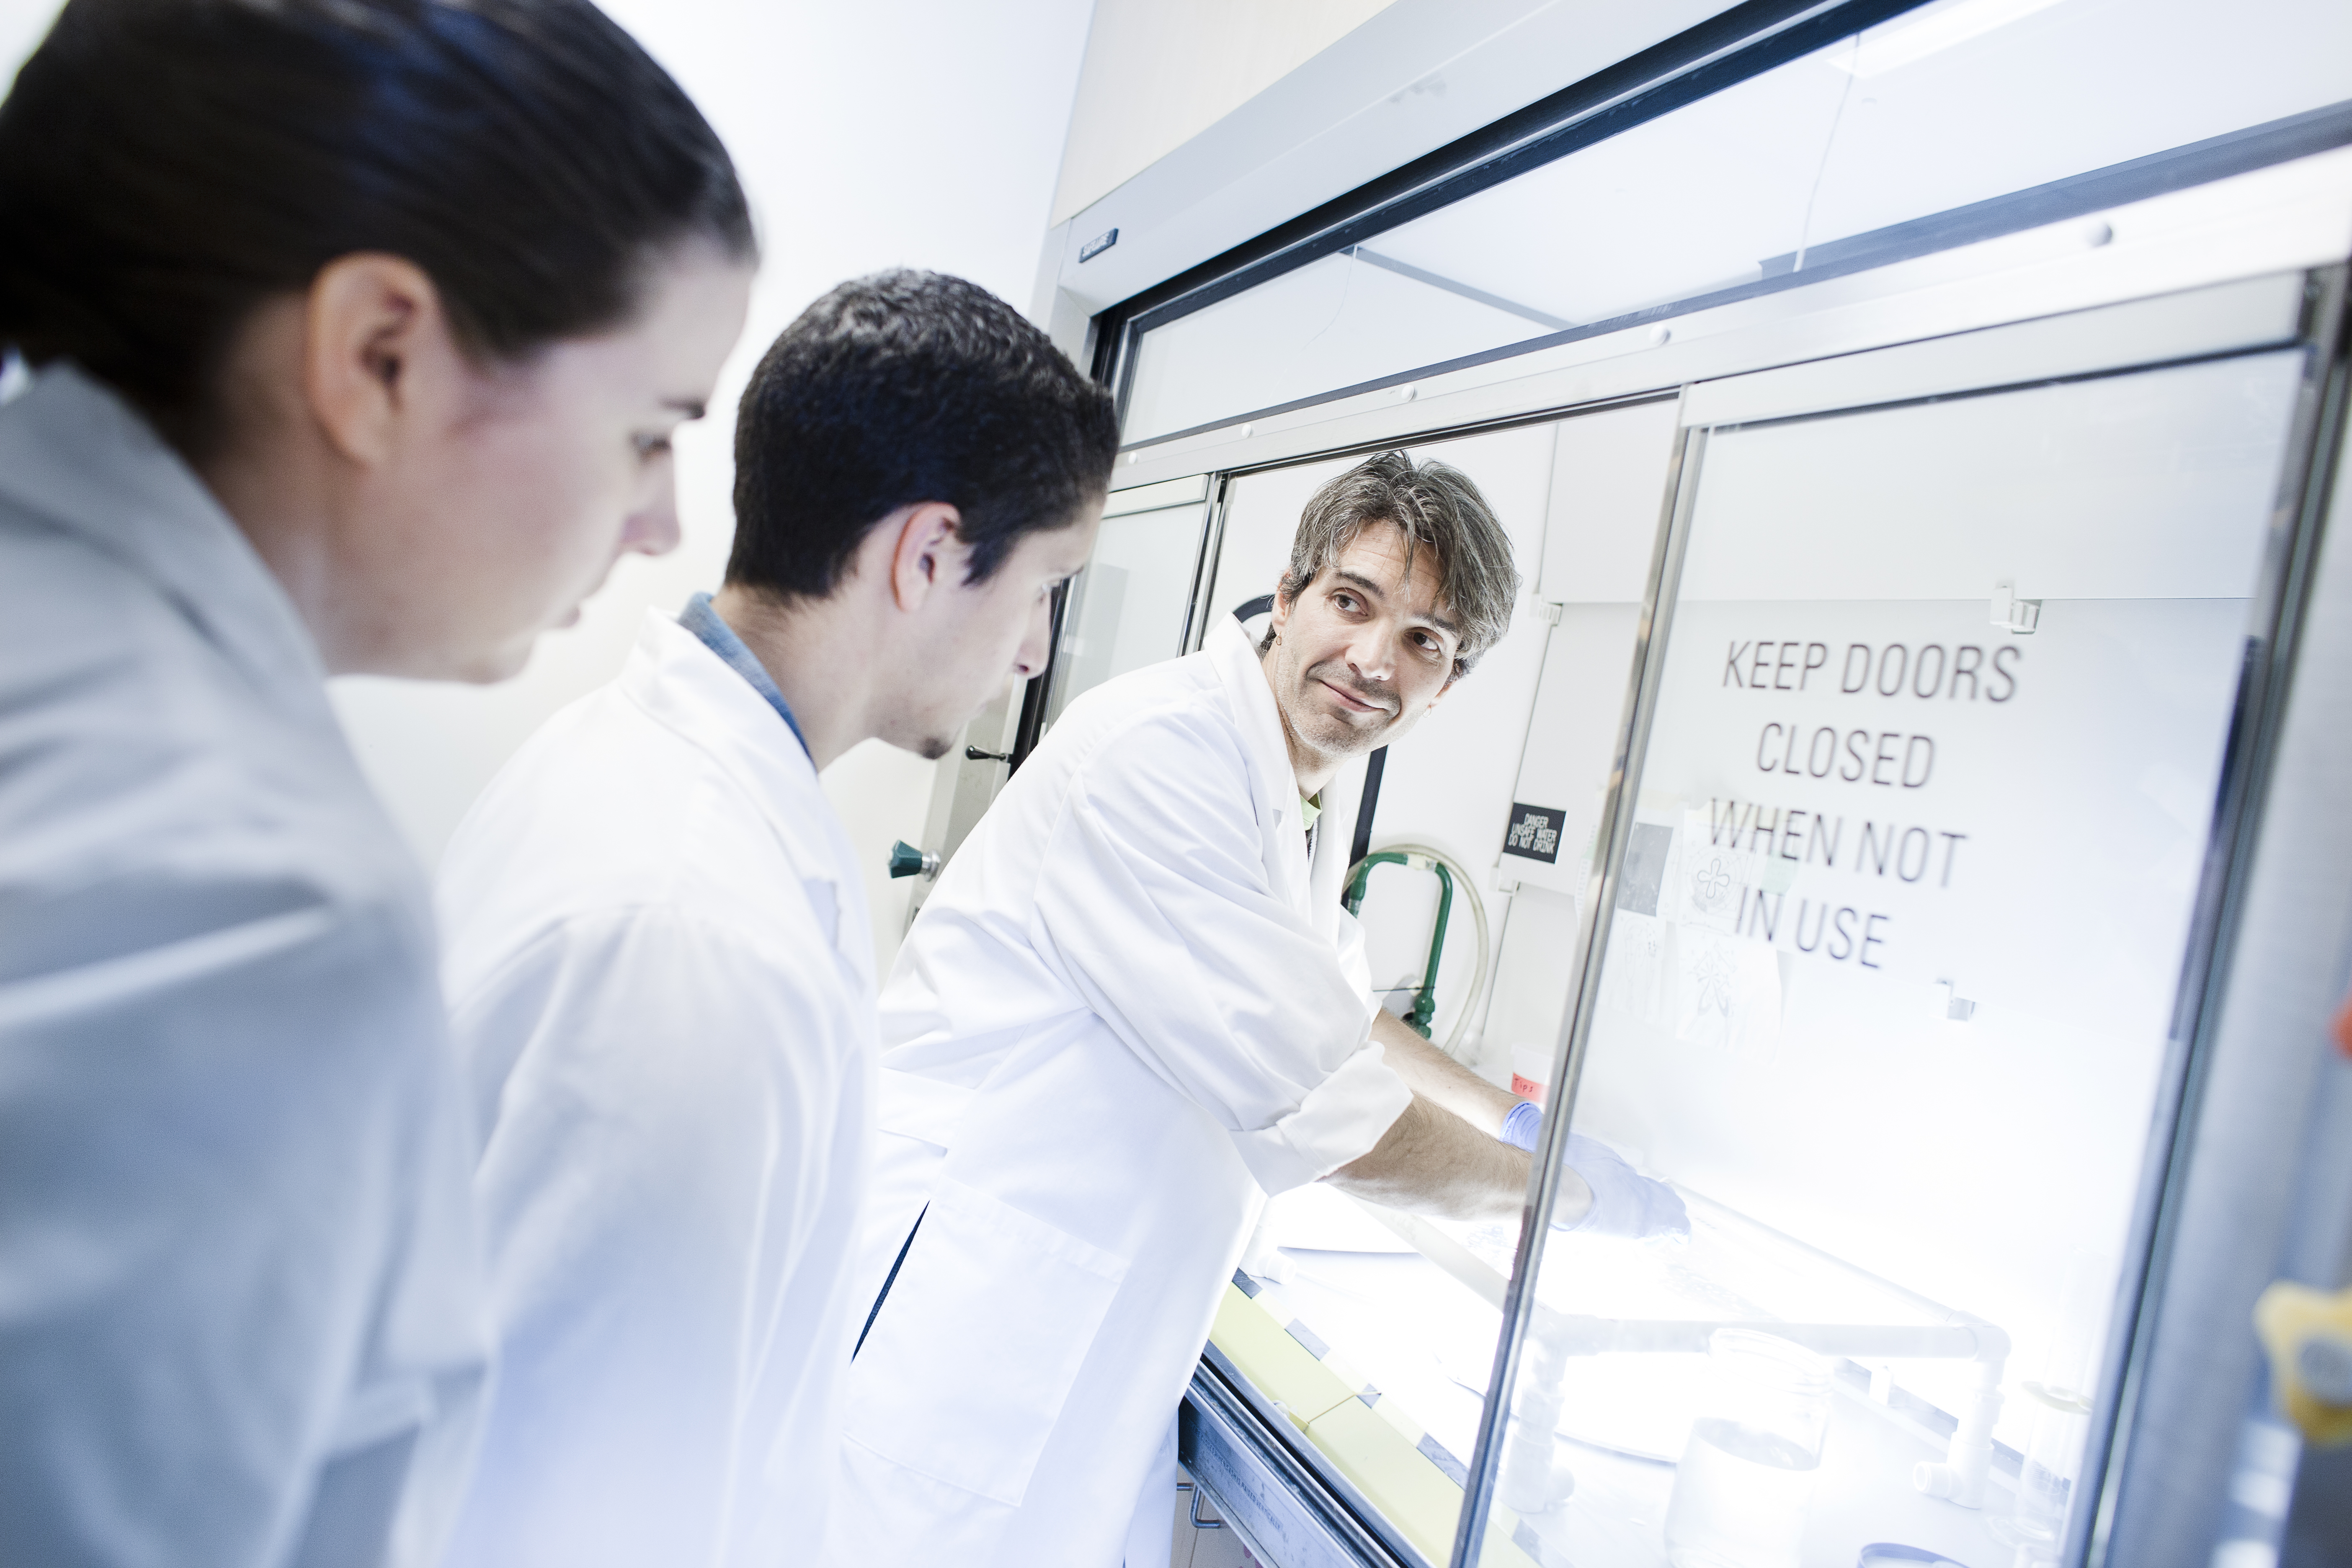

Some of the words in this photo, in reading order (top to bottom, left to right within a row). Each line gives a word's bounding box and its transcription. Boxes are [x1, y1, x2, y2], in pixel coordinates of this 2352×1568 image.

[1723, 640, 1828, 692] KEEP
[1841, 643, 2024, 704] DOORS
[1757, 722, 1935, 788] CLOSED
[1511, 823, 1536, 838] UNSAFE
[1537, 828, 1557, 843] WATER
[1524, 813, 1549, 828] DANGER
[1508, 833, 1519, 846] DO
[1519, 836, 1532, 848] NOT
[1533, 839, 1555, 854] DRINK
[1710, 798, 1844, 867] WHEN
[1855, 821, 1968, 888] NOT
[1734, 885, 1787, 942] IN
[1796, 898, 1891, 969] USE
[1514, 1078, 1533, 1092] Tips
